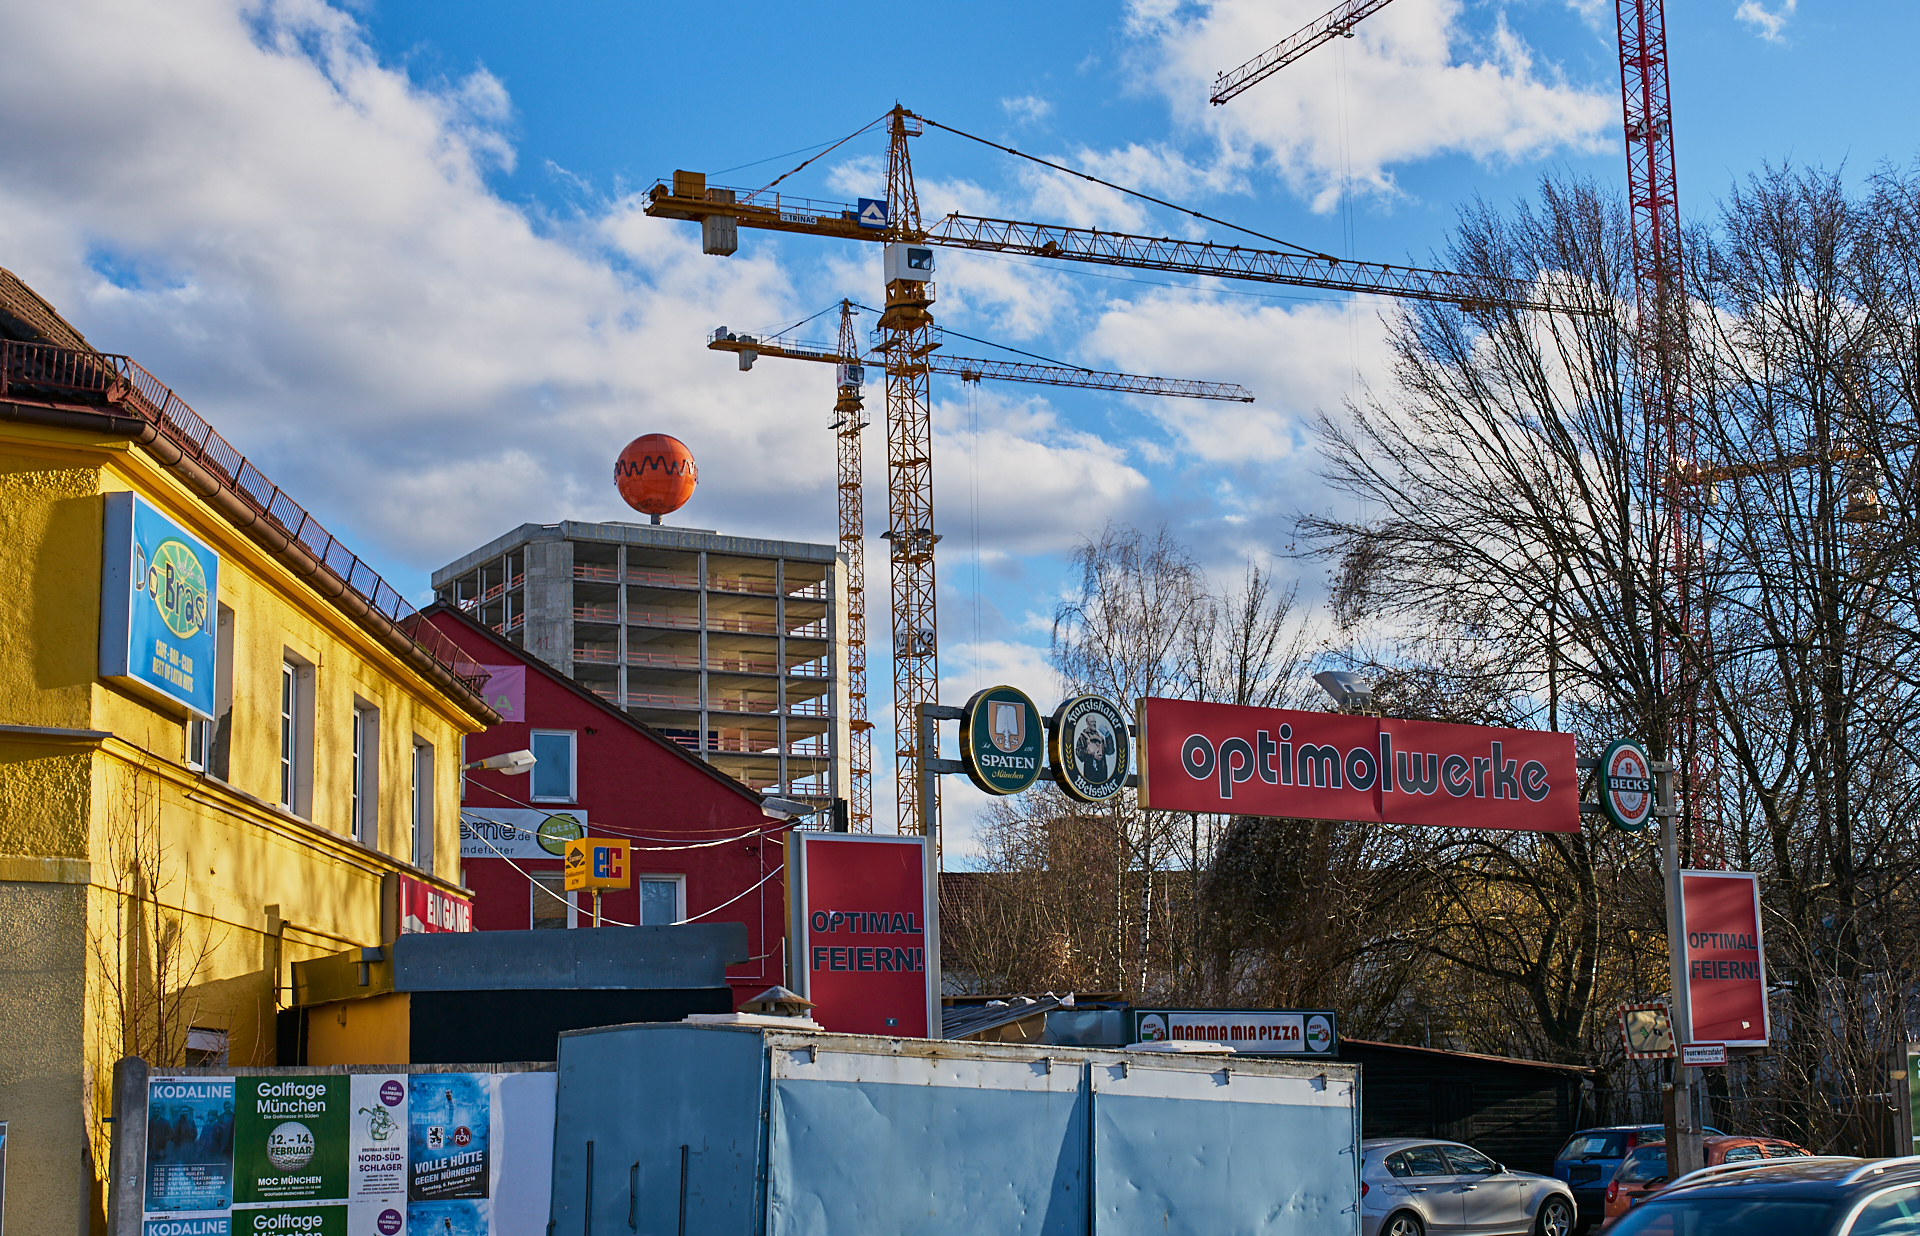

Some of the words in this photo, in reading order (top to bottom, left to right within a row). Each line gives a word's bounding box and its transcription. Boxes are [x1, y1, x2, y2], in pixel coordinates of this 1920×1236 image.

[789, 214, 816, 224] TRINAC
[165, 560, 212, 636] Brasil
[896, 632, 905, 649] K2
[917, 630, 934, 646] K2
[170, 647, 179, 667] BAR
[181, 654, 193, 674] CLUB
[152, 656, 165, 677] BEST
[164, 663, 171, 680] OF
[170, 667, 183, 687] LATIN
[183, 673, 193, 693] HITS
[1067, 699, 1122, 729] Franziskaner
[981, 754, 1035, 769] SPATEN
[1180, 722, 1551, 803] optimolwerke
[992, 769, 1024, 779] München
[1074, 774, 1119, 797] Weissbier
[1610, 778, 1649, 791] BECK'S
[545, 823, 576, 834] Jetzt
[427, 892, 469, 932] EINGANG
[811, 911, 923, 934] OPTIMAL
[1689, 932, 1757, 950] OPTIMAL
[812, 946, 924, 972] FEIERN!
[1690, 960, 1759, 980] FEIERN!
[1172, 1025, 1228, 1041] MAMMA
[1230, 1025, 1257, 1041] MIA
[1259, 1025, 1300, 1041] PIZZA
[153, 1085, 232, 1099] KODALINE
[257, 1082, 326, 1099] Golftage
[257, 1099, 326, 1113] München
[271, 1134, 287, 1144] 12.
[297, 1134, 312, 1144] 14.
[456, 1134, 470, 1142] FCN
[271, 1146, 312, 1155] FEBRUAR
[358, 1152, 404, 1162] NORD-SÜD-
[359, 1164, 402, 1172] SCHLAGER
[415, 1158, 448, 1175] VOLLE
[450, 1149, 483, 1166] HÜTTE
[258, 1178, 279, 1186] MOC
[281, 1175, 322, 1185] MÜNCHEN
[415, 1172, 439, 1186] GEGEN
[441, 1164, 482, 1181] NÜRNBERG!
[148, 1220, 227, 1236] KODALINE
[253, 1213, 323, 1231] Golftage
